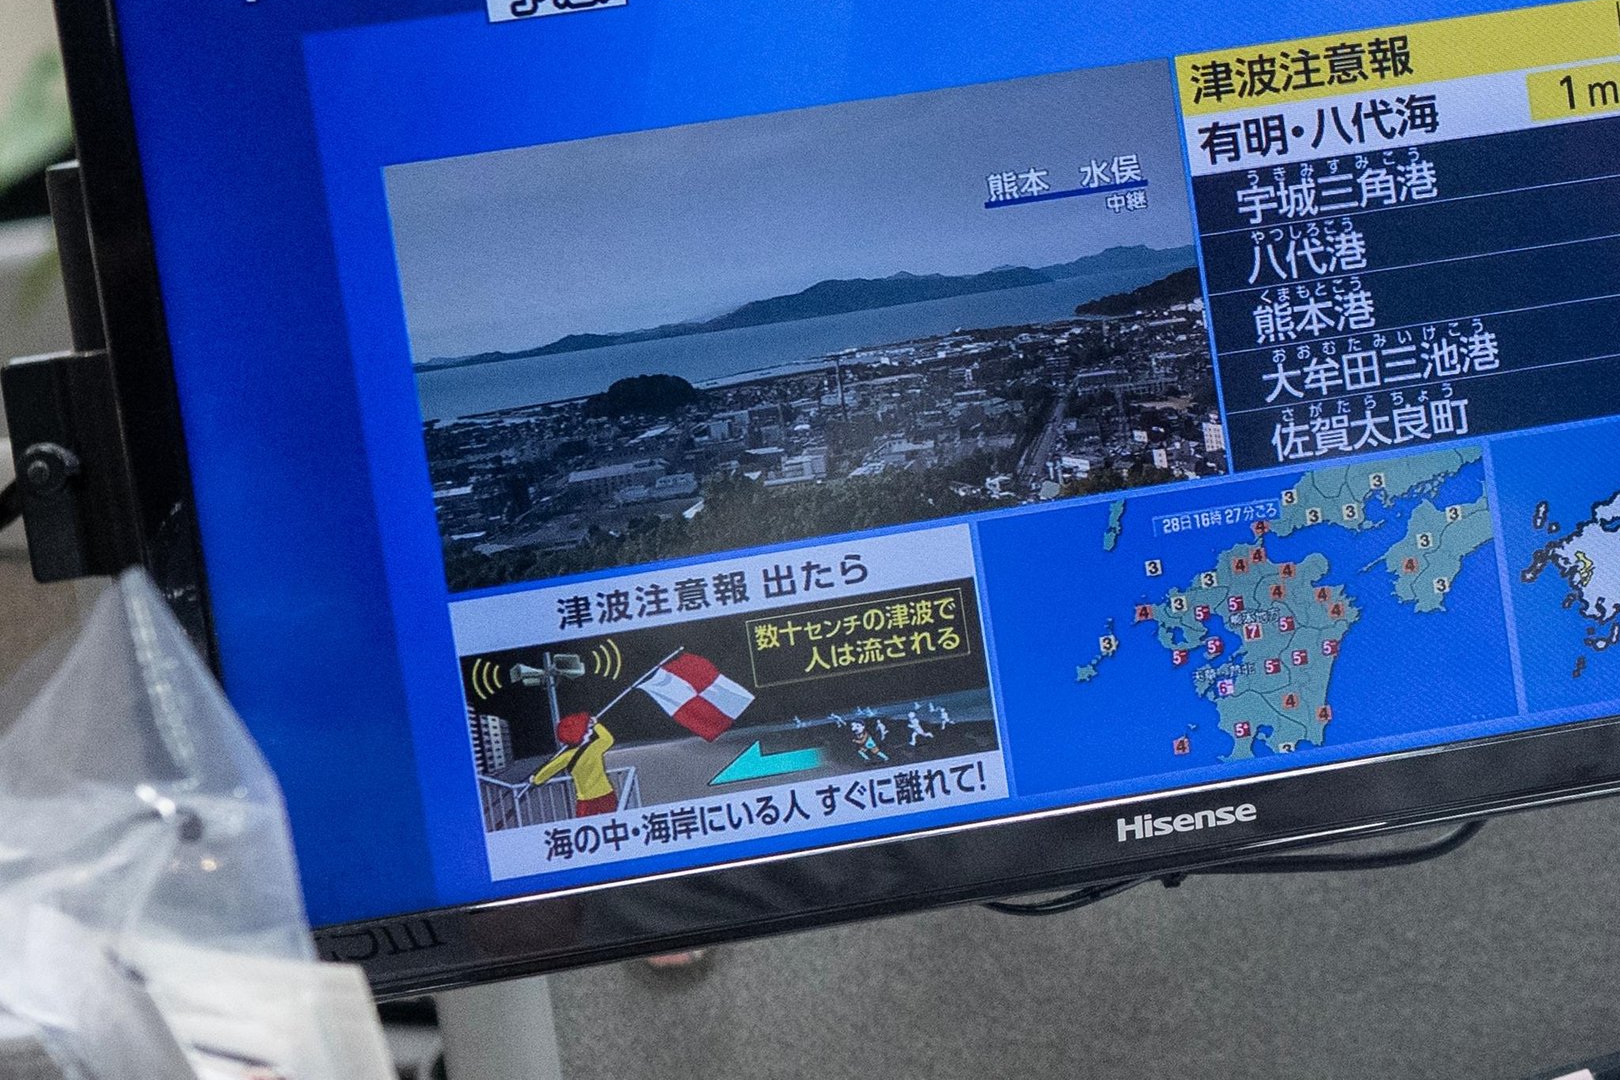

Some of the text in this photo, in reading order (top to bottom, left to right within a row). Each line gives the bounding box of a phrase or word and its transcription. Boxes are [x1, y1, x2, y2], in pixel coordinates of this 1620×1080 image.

[1190, 35, 1414, 104] 津波注意報
[987, 154, 1142, 202] 熊本 水俣
[1107, 190, 1148, 213] 中継
[1237, 161, 1438, 224] 宇城三角港
[1248, 231, 1367, 284] 八代港
[1253, 291, 1375, 344] 熊本港
[1262, 332, 1500, 403] 大牟田三池港
[1271, 399, 1468, 462] 佐賀太良町
[556, 553, 870, 631] 津波注意報 出たら
[754, 596, 958, 653] 数十センチの津波で
[804, 627, 961, 673] 人は流される
[1117, 802, 1257, 842] Hisense
